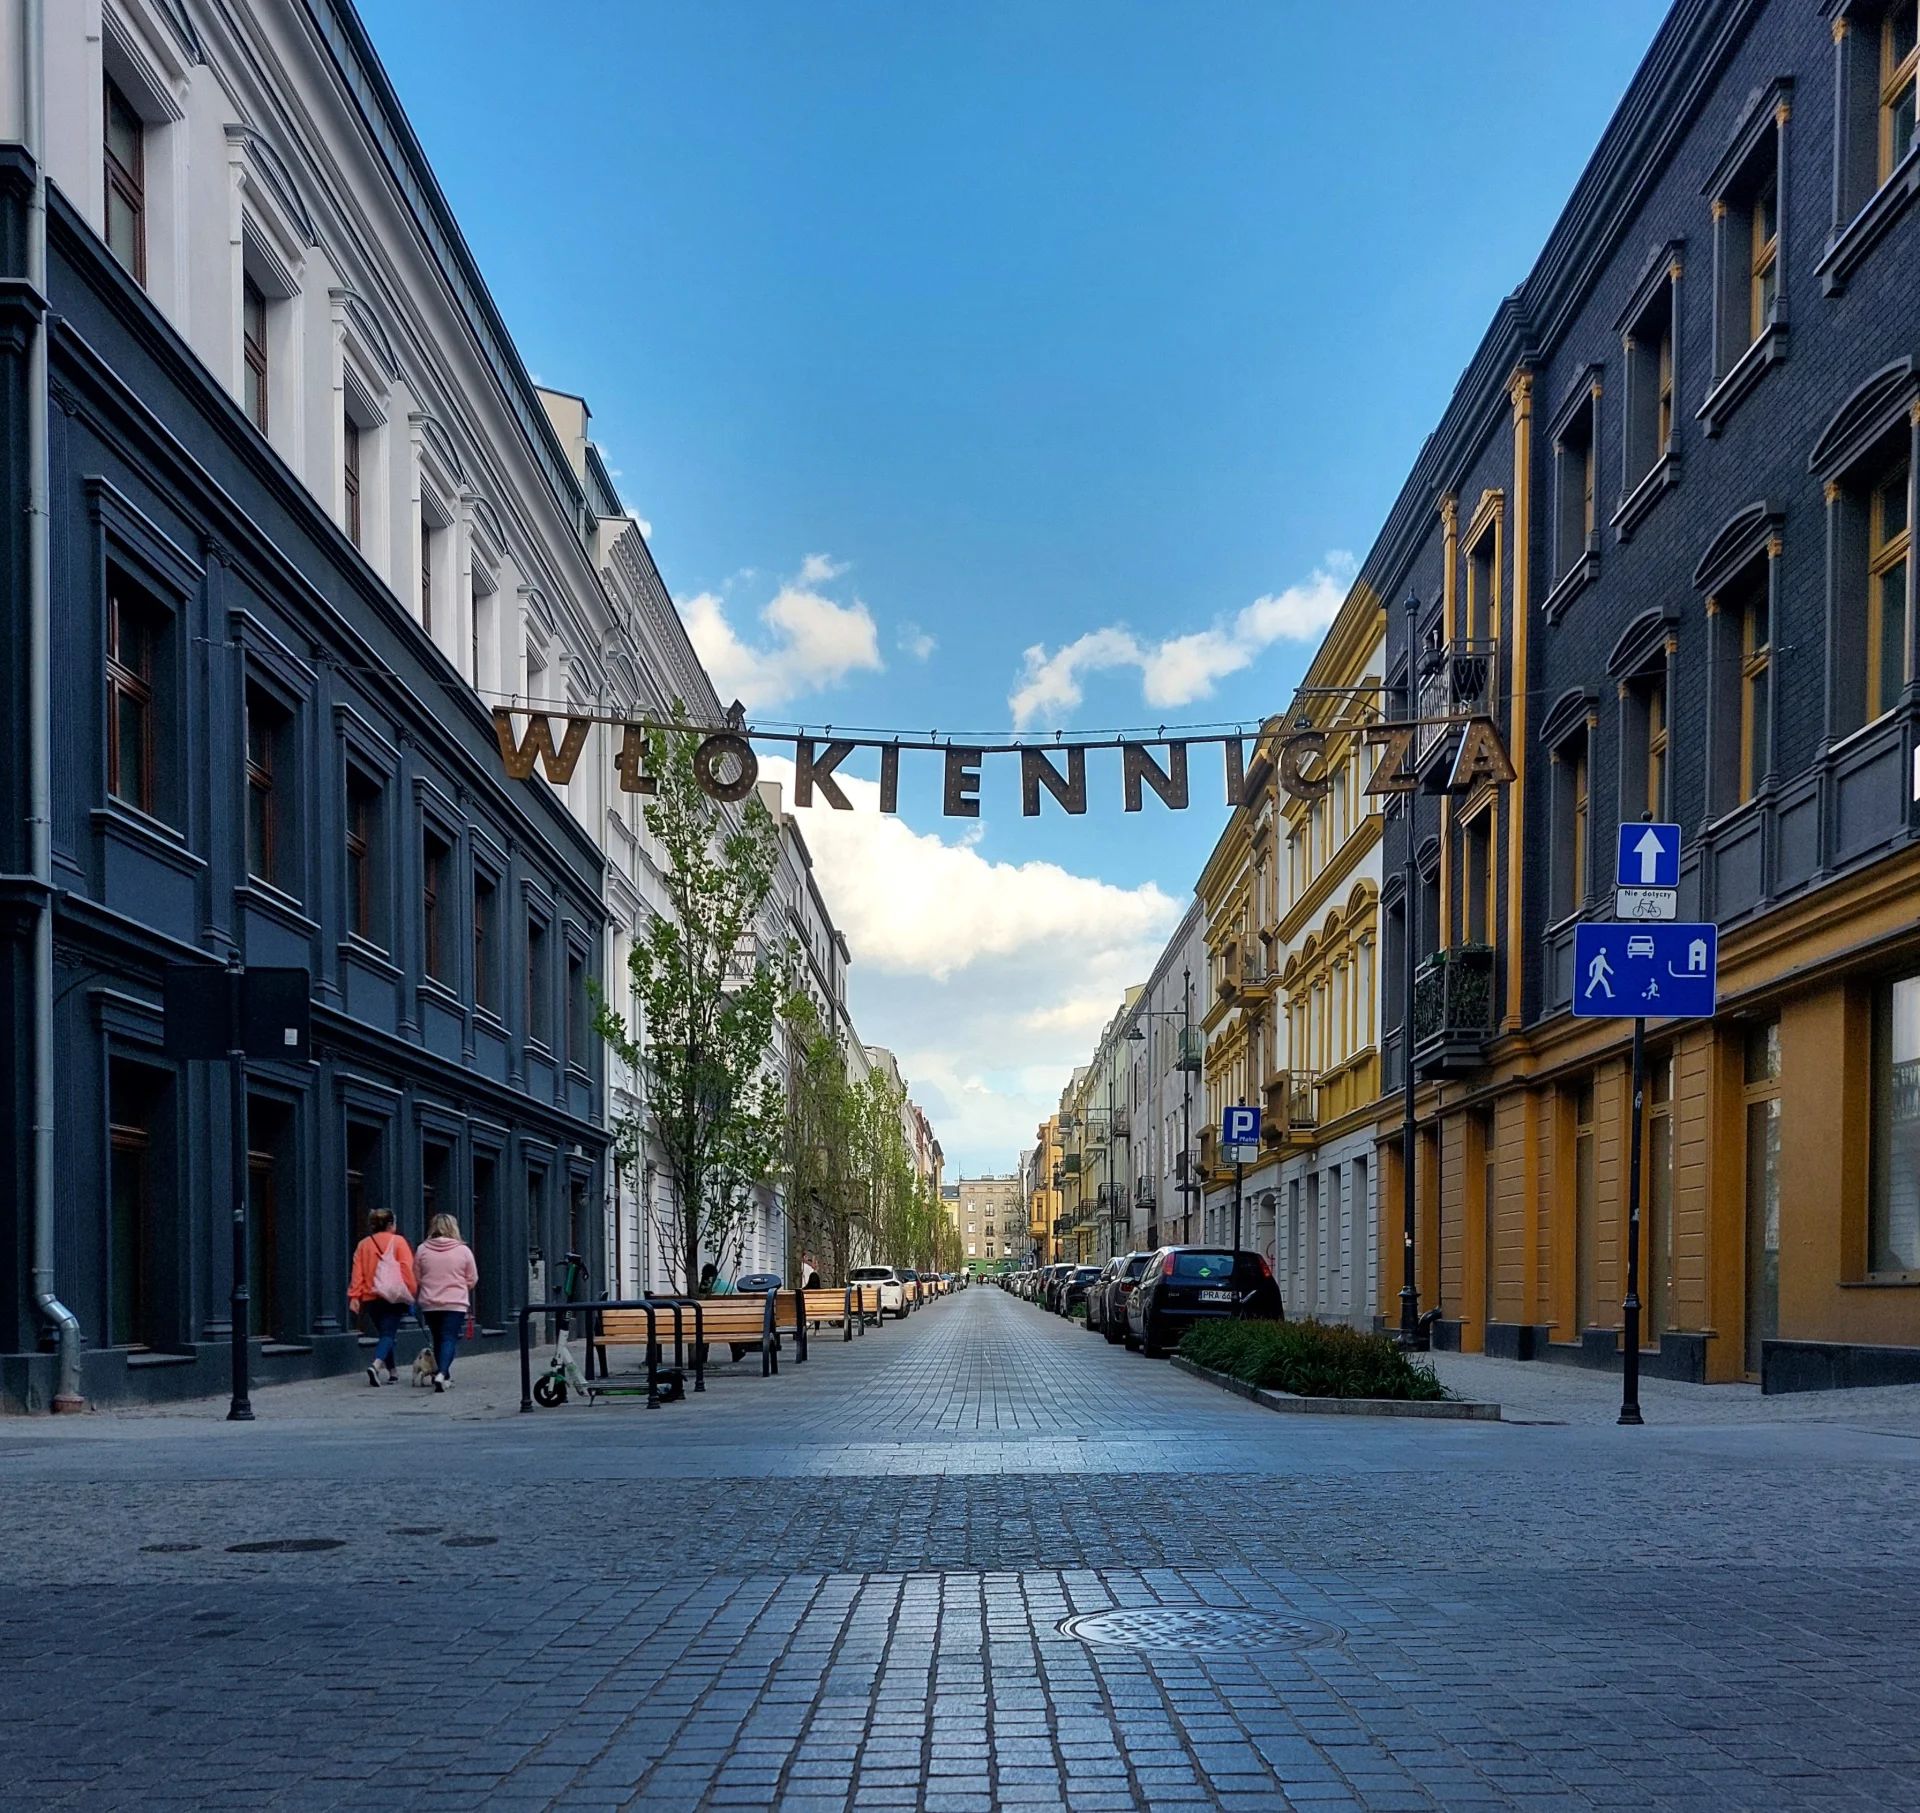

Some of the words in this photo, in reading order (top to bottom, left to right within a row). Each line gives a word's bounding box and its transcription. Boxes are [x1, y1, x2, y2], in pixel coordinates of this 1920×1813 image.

[1642, 890, 1671, 899] dotyczy
[1232, 1110, 1254, 1139] P
[1203, 1290, 1220, 1299] PRA
